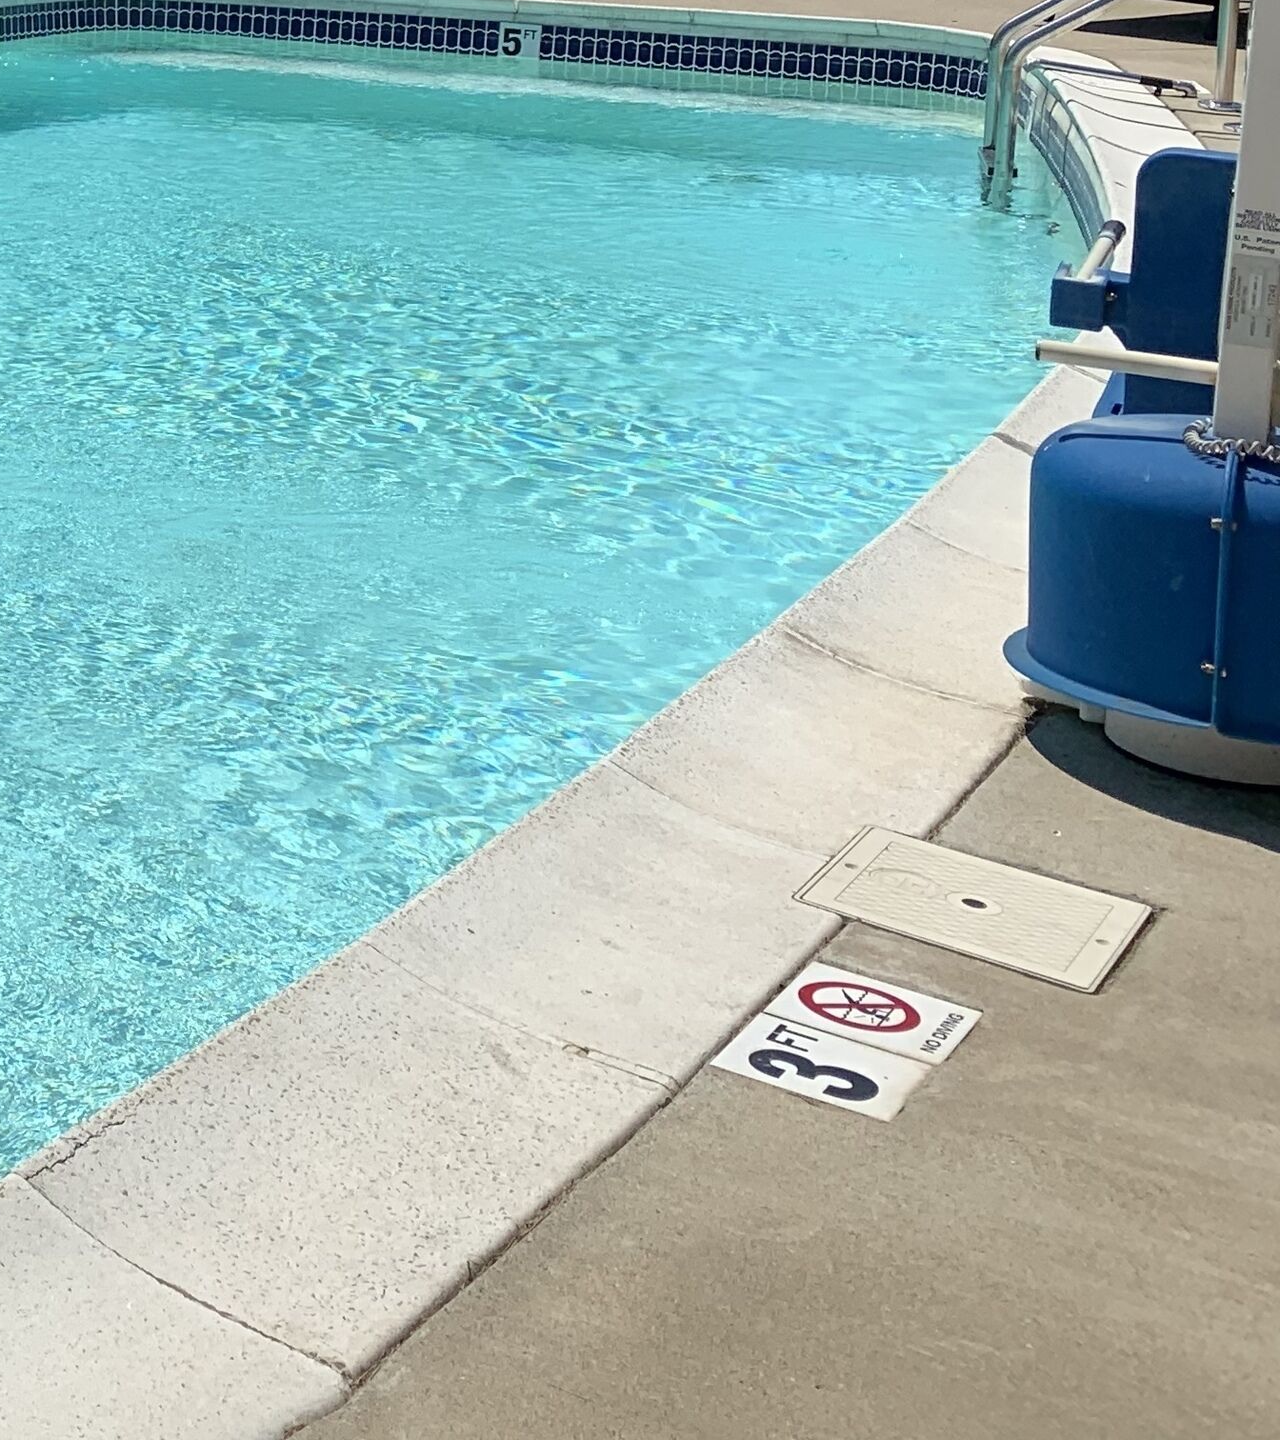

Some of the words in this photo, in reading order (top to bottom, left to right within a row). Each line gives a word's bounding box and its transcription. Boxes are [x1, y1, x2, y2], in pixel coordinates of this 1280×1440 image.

[502, 28, 522, 56] 5
[524, 29, 537, 40] FT
[1241, 243, 1275, 254] Pending
[766, 1023, 818, 1052] FT
[920, 1039, 941, 1054] NO
[938, 1012, 965, 1043] DIVING
[748, 1049, 879, 1102] 3
